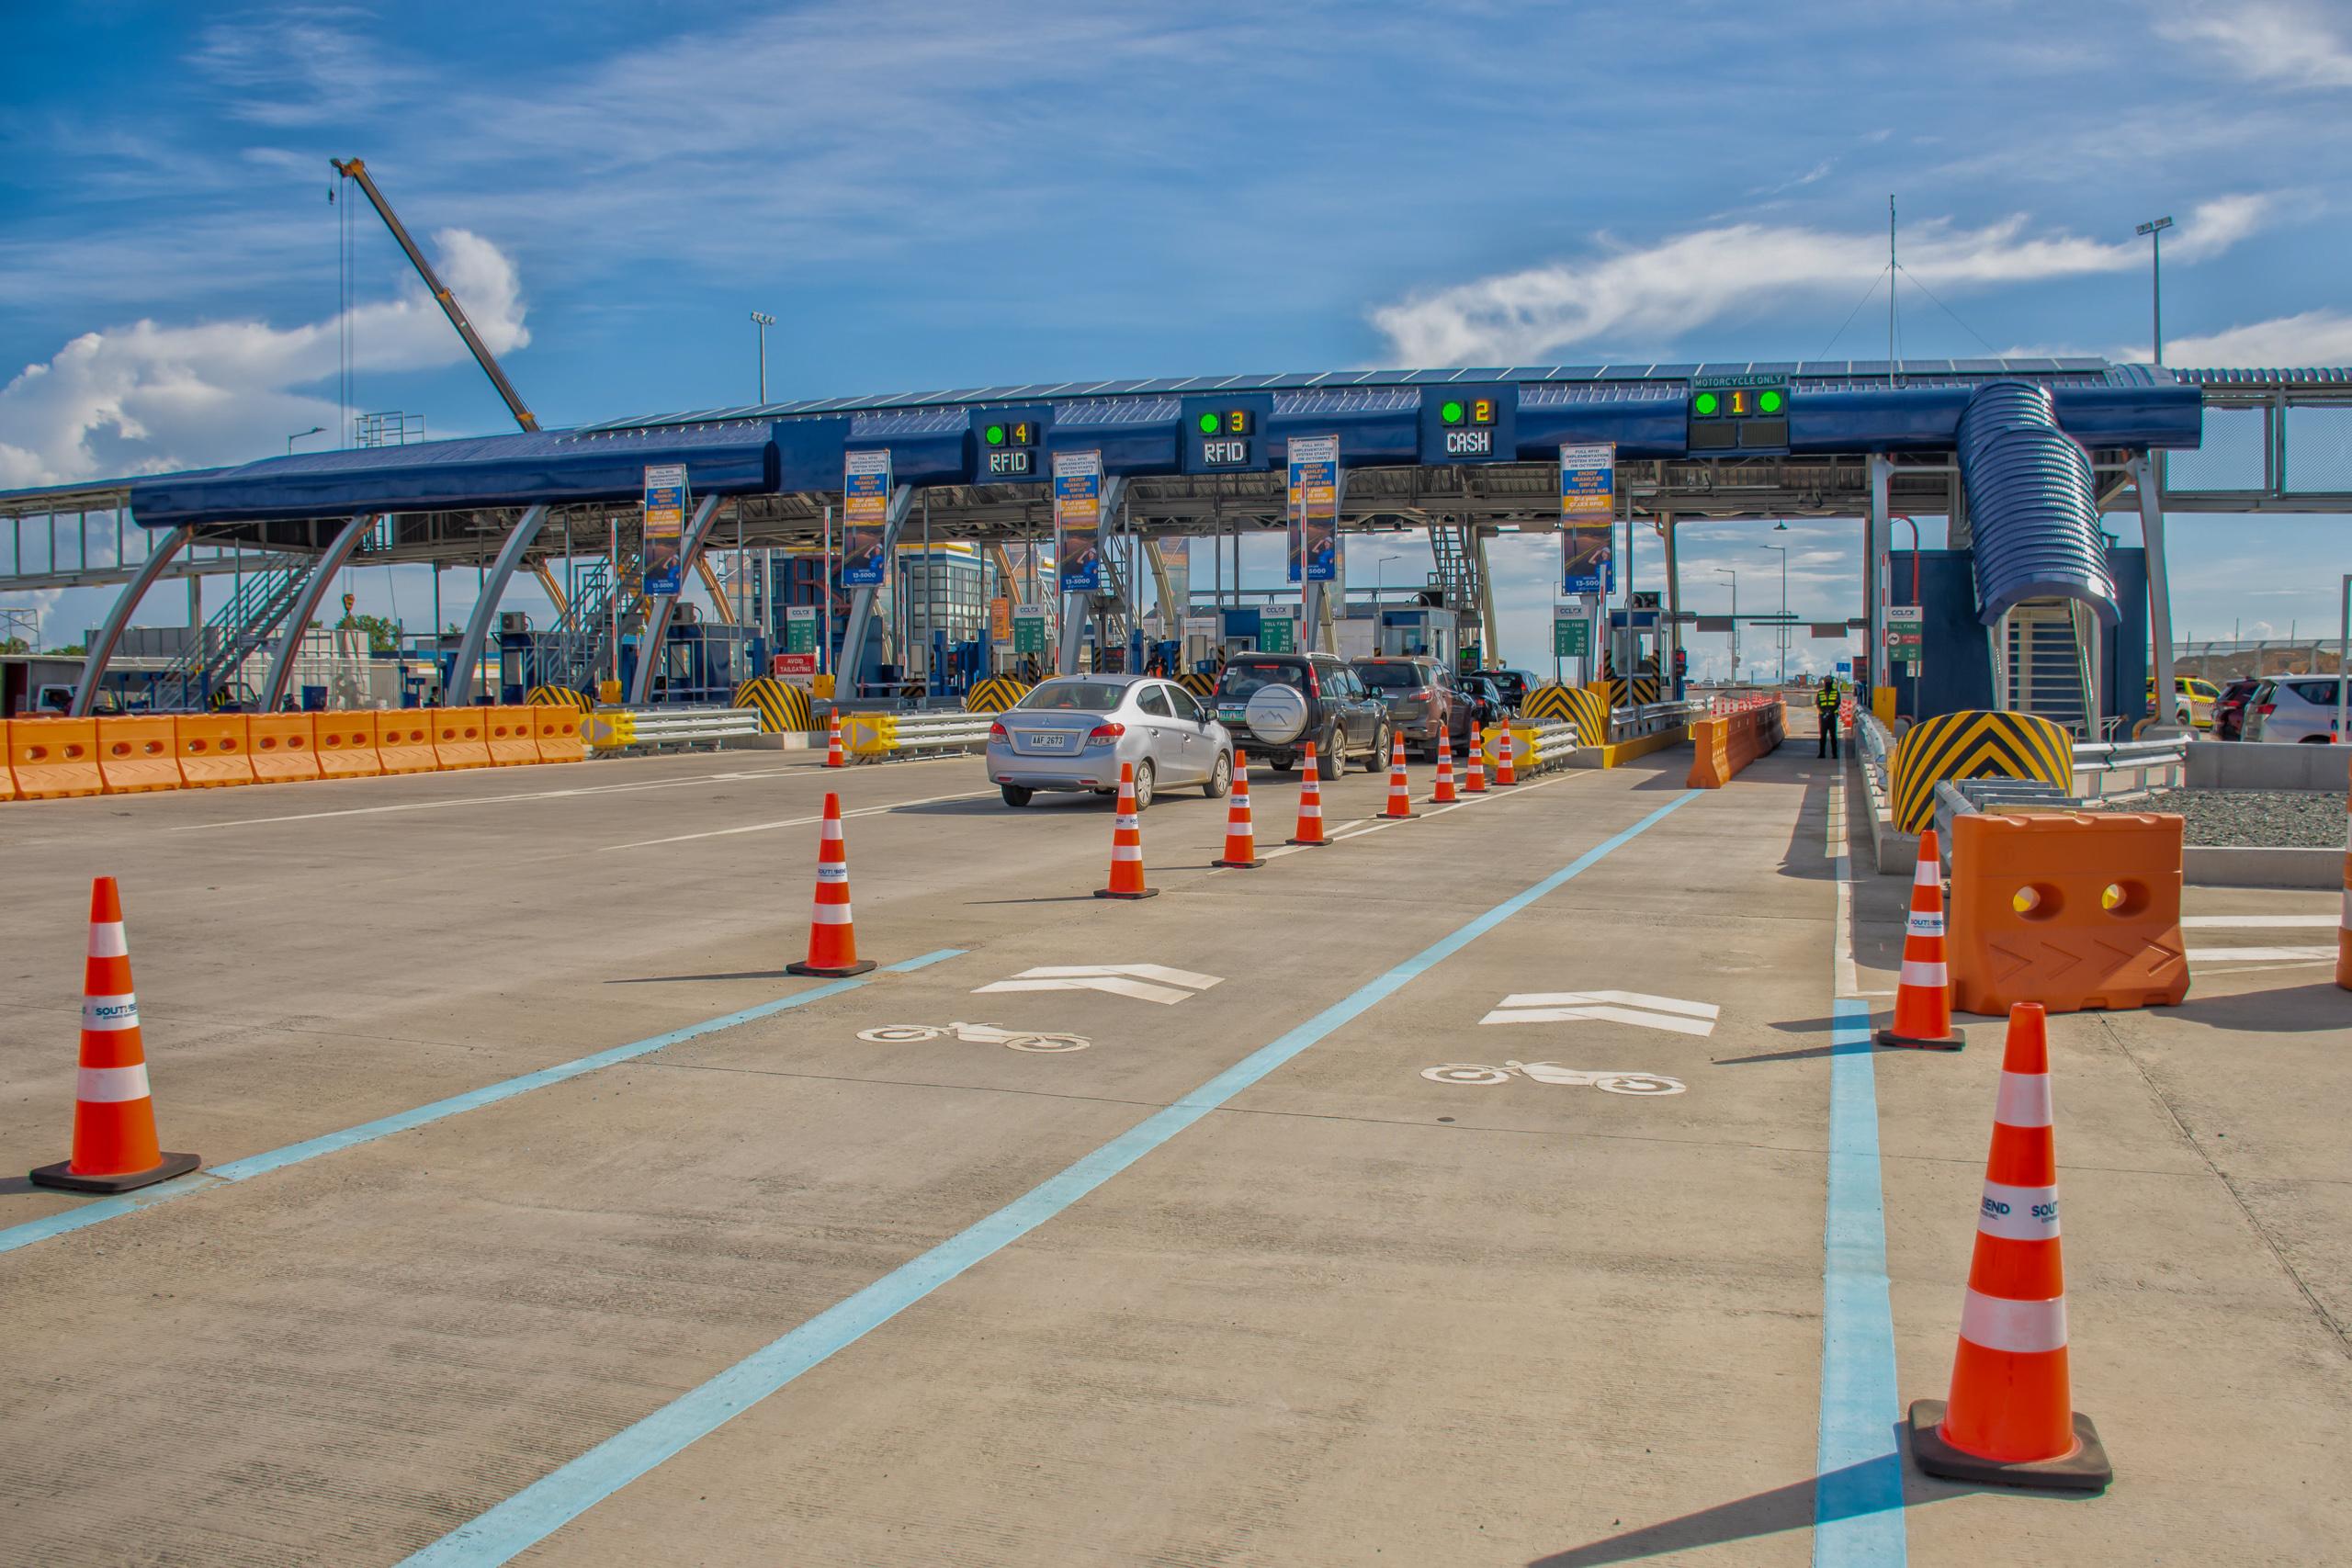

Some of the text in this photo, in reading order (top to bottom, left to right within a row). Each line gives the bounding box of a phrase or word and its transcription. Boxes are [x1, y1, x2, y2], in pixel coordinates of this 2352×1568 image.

[1694, 375, 1782, 387] MOTORCYCLE ONLY
[1476, 400, 1488, 422] 2
[1733, 391, 1744, 413] 1
[1231, 411, 1243, 432] 3
[1016, 423, 1026, 443] 4
[1447, 432, 1488, 453] CASH
[989, 452, 1027, 472] RFID
[1204, 442, 1244, 462] RFID
[1047, 736, 1063, 744] 2673
